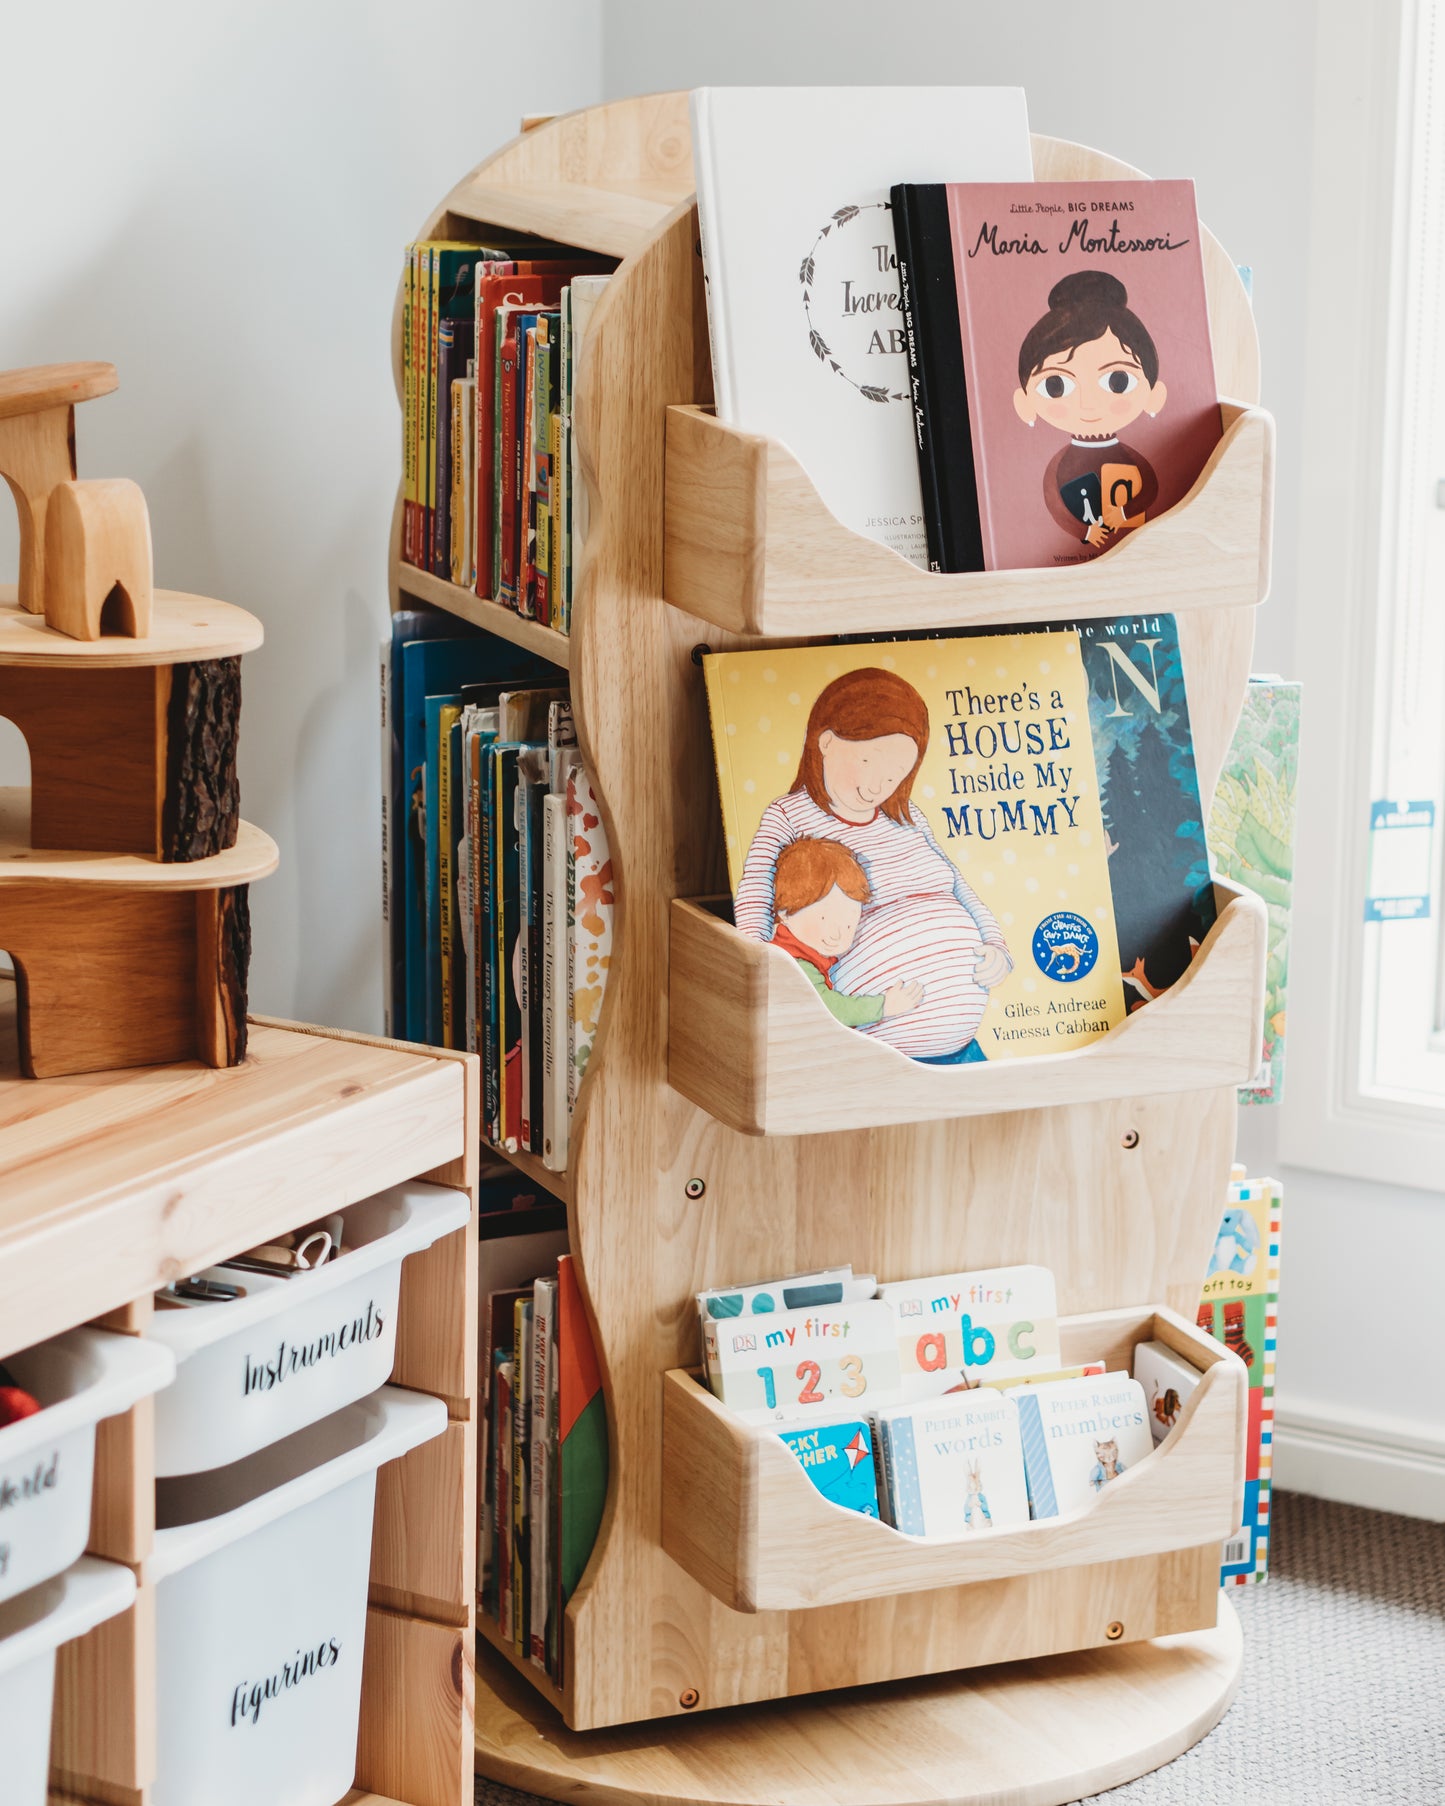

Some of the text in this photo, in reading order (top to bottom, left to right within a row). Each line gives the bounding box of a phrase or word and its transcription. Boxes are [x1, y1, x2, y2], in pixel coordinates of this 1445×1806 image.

[1010, 201, 1135, 216] Little People, BIG DREAMS
[968, 218, 1190, 258] Maria Montessori
[905, 311, 913, 329] BIG
[908, 329, 917, 368] DREAMS
[911, 375, 920, 403] Maria
[865, 516, 906, 528] JESSICA
[1105, 617, 1161, 636] world
[945, 682, 1064, 716] There's a
[944, 717, 1071, 759] HOUSE
[473, 779, 479, 787] A
[949, 761, 1073, 794] Inside My
[941, 795, 1081, 840] MUMMY
[482, 816, 490, 887] AUSTRALIAN
[519, 844, 527, 889] HUNGRY
[567, 850, 576, 928] ZEBRA
[545, 920, 553, 947] Very
[1063, 931, 1090, 944] DANCE
[544, 952, 553, 1001] Hungry
[1004, 998, 1107, 1018] Giles Andreae
[544, 1006, 553, 1077] Caterpillar
[992, 1018, 1110, 1041] Vanessa Cabban
[931, 1292, 961, 1314] my
[969, 1284, 1013, 1304] first
[1230, 1279, 1252, 1291] toy
[243, 1299, 386, 1397] Instruments
[735, 1317, 850, 1351] DK my first
[1050, 1391, 1133, 1414] PETER RABBIT
[924, 1409, 1009, 1433] PETER RABBIT
[1050, 1410, 1144, 1439] numbers
[869, 1417, 883, 1486] numbers
[934, 1427, 1004, 1456] words
